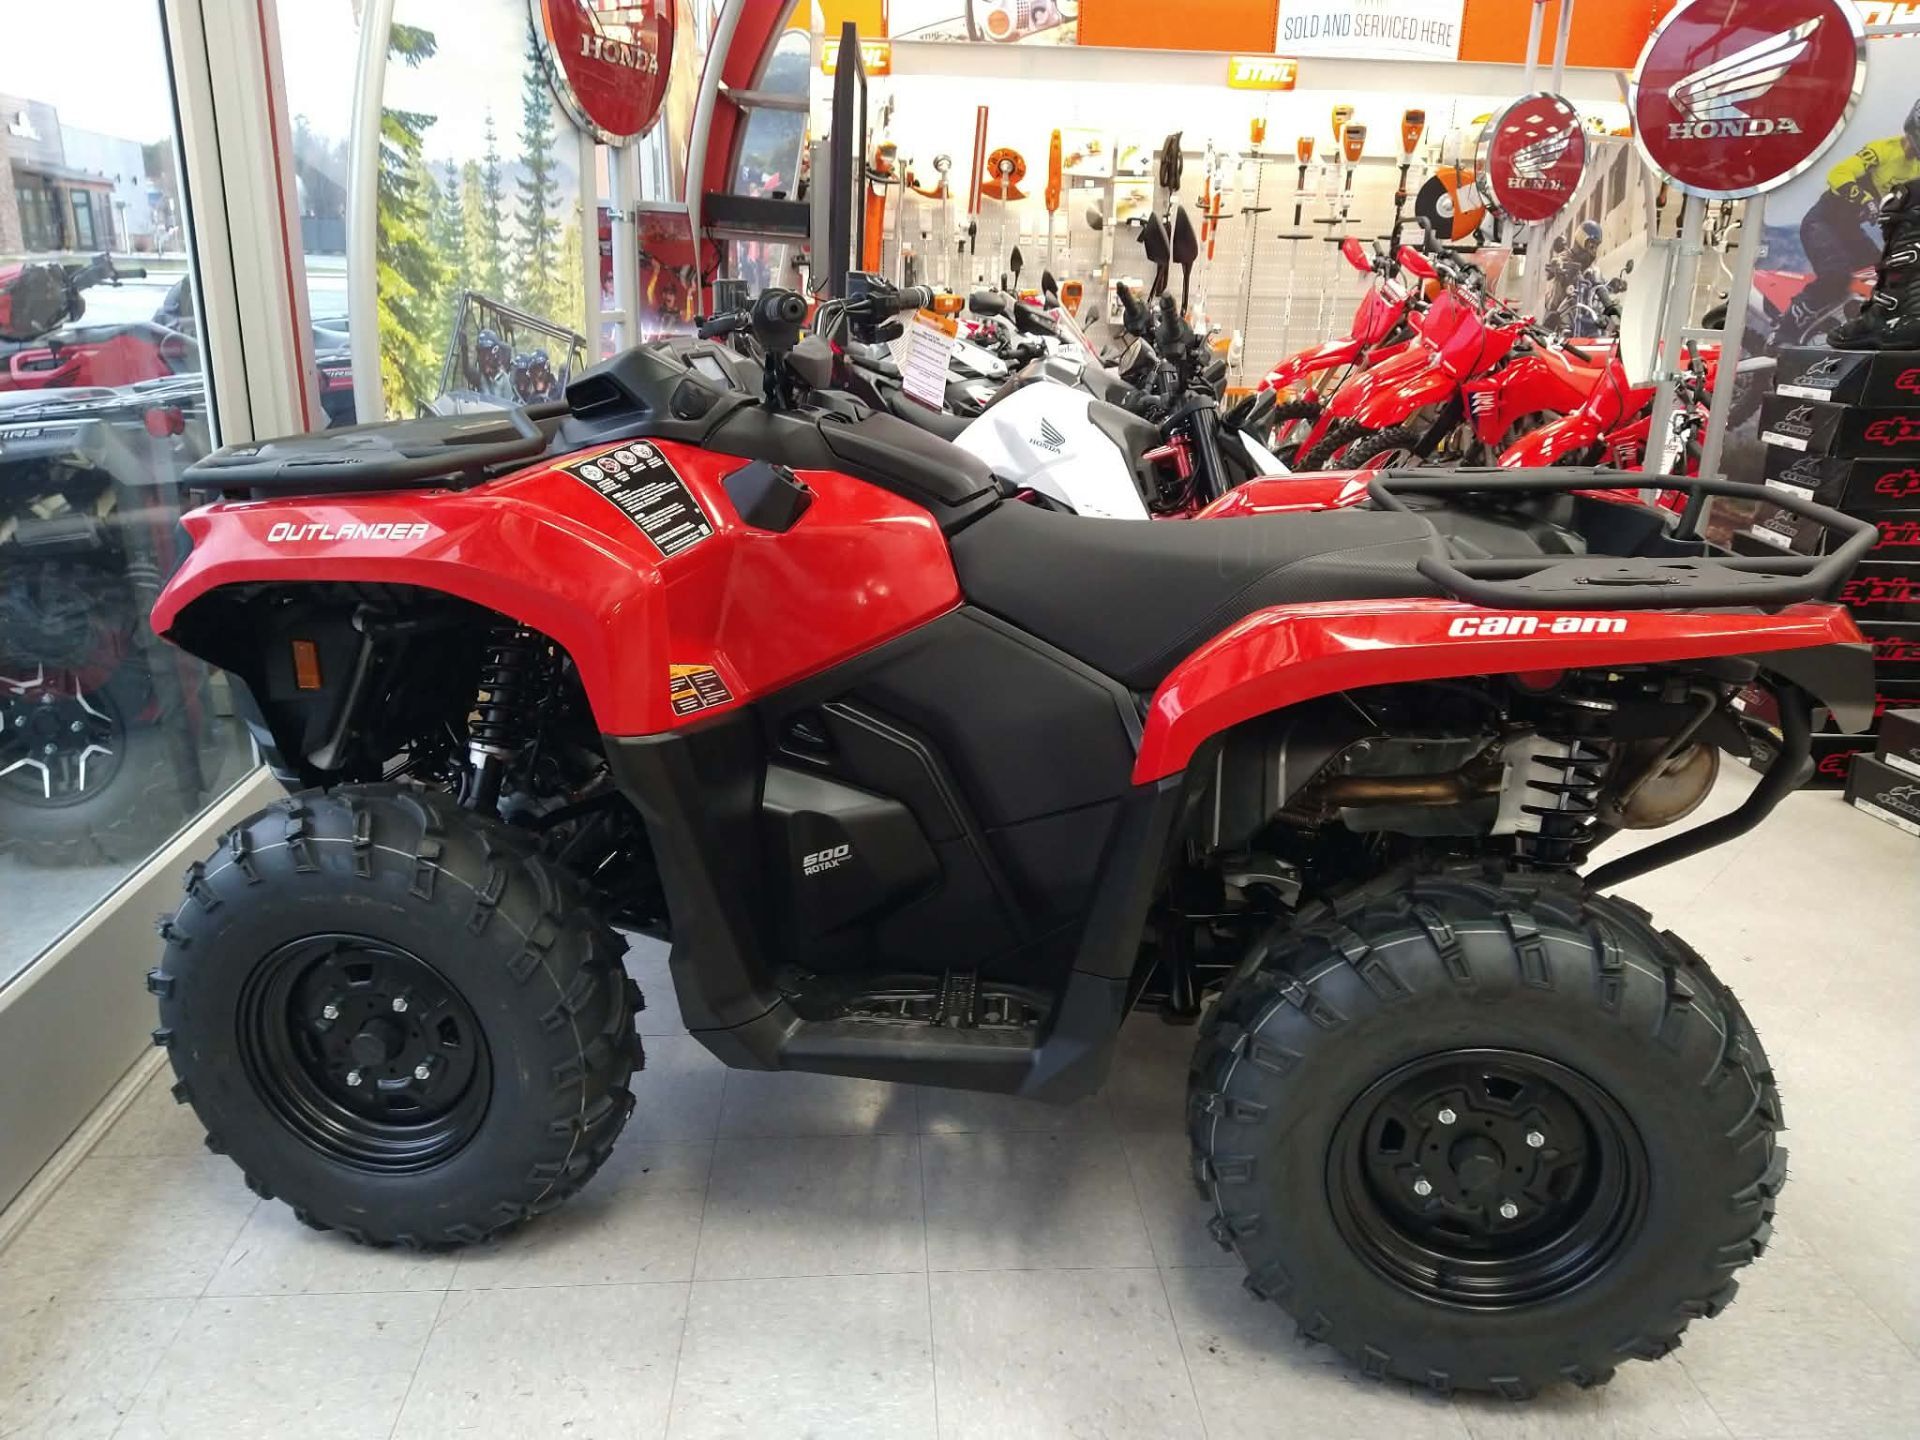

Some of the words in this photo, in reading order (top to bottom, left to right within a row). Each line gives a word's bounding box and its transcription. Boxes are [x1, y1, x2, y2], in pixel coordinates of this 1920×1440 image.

[1284, 14, 1319, 41] SOLD
[1322, 13, 1351, 37] AND
[1353, 13, 1418, 41] SERVICED
[1421, 20, 1454, 47] HERE
[581, 33, 659, 75] HONDA
[1234, 64, 1295, 83] STIHL
[1667, 117, 1803, 140] HONDA
[1508, 177, 1567, 191] HONDA
[266, 522, 430, 543] OUTLANDER
[1447, 616, 1628, 637] can-am
[803, 844, 849, 868] 500
[804, 859, 841, 876] ROTAX
